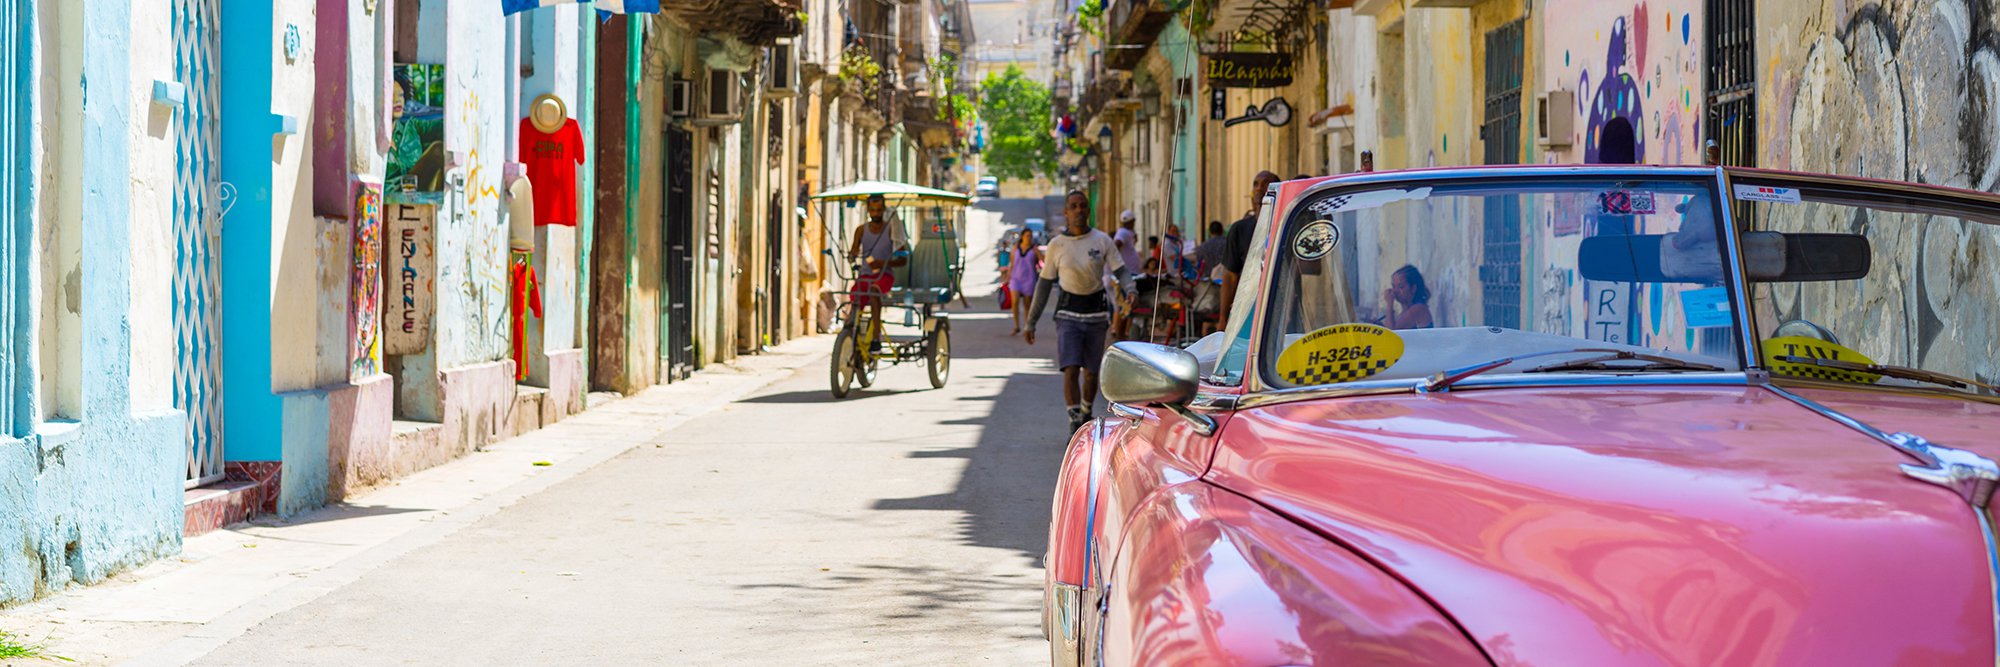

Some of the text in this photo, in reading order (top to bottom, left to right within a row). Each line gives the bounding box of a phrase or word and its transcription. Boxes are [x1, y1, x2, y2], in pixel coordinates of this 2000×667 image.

[1302, 327, 1337, 345] AGENCIA
[1352, 325, 1371, 334] TAXI
[1307, 345, 1373, 366] H-3264
